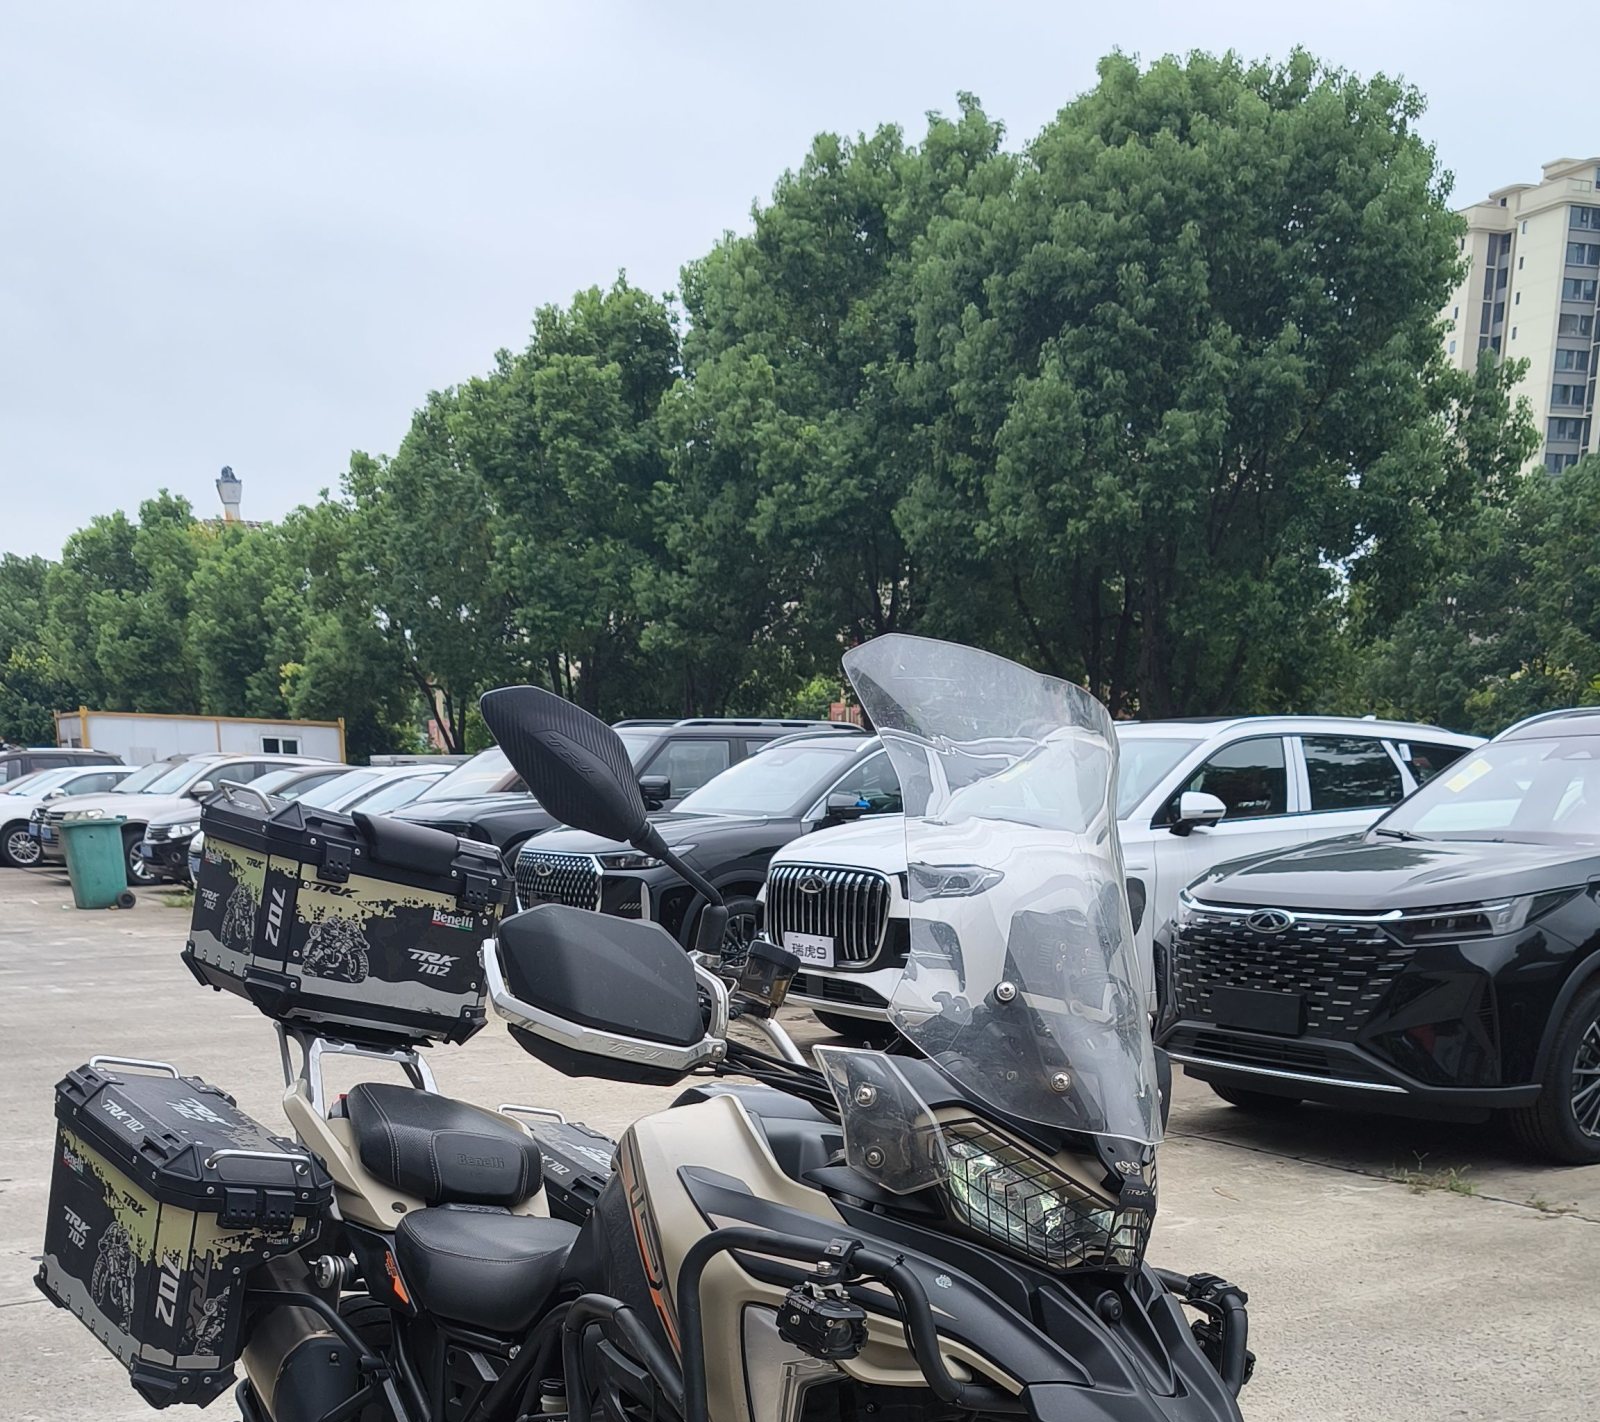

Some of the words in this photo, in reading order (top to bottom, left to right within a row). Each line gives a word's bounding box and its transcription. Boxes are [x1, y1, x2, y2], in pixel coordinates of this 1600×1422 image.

[246, 857, 265, 869] TRK
[201, 888, 220, 902] TRK
[310, 880, 361, 898] TRK
[203, 899, 217, 911] 702
[265, 887, 286, 947] 702
[432, 909, 474, 928] Benelli
[408, 948, 460, 967] TRK
[418, 962, 450, 977] 702
[457, 1153, 505, 1169] Benelli
[122, 1190, 148, 1217] TRK
[64, 1205, 92, 1238] TRK
[68, 1226, 86, 1250] 702
[155, 1253, 182, 1327] 702
